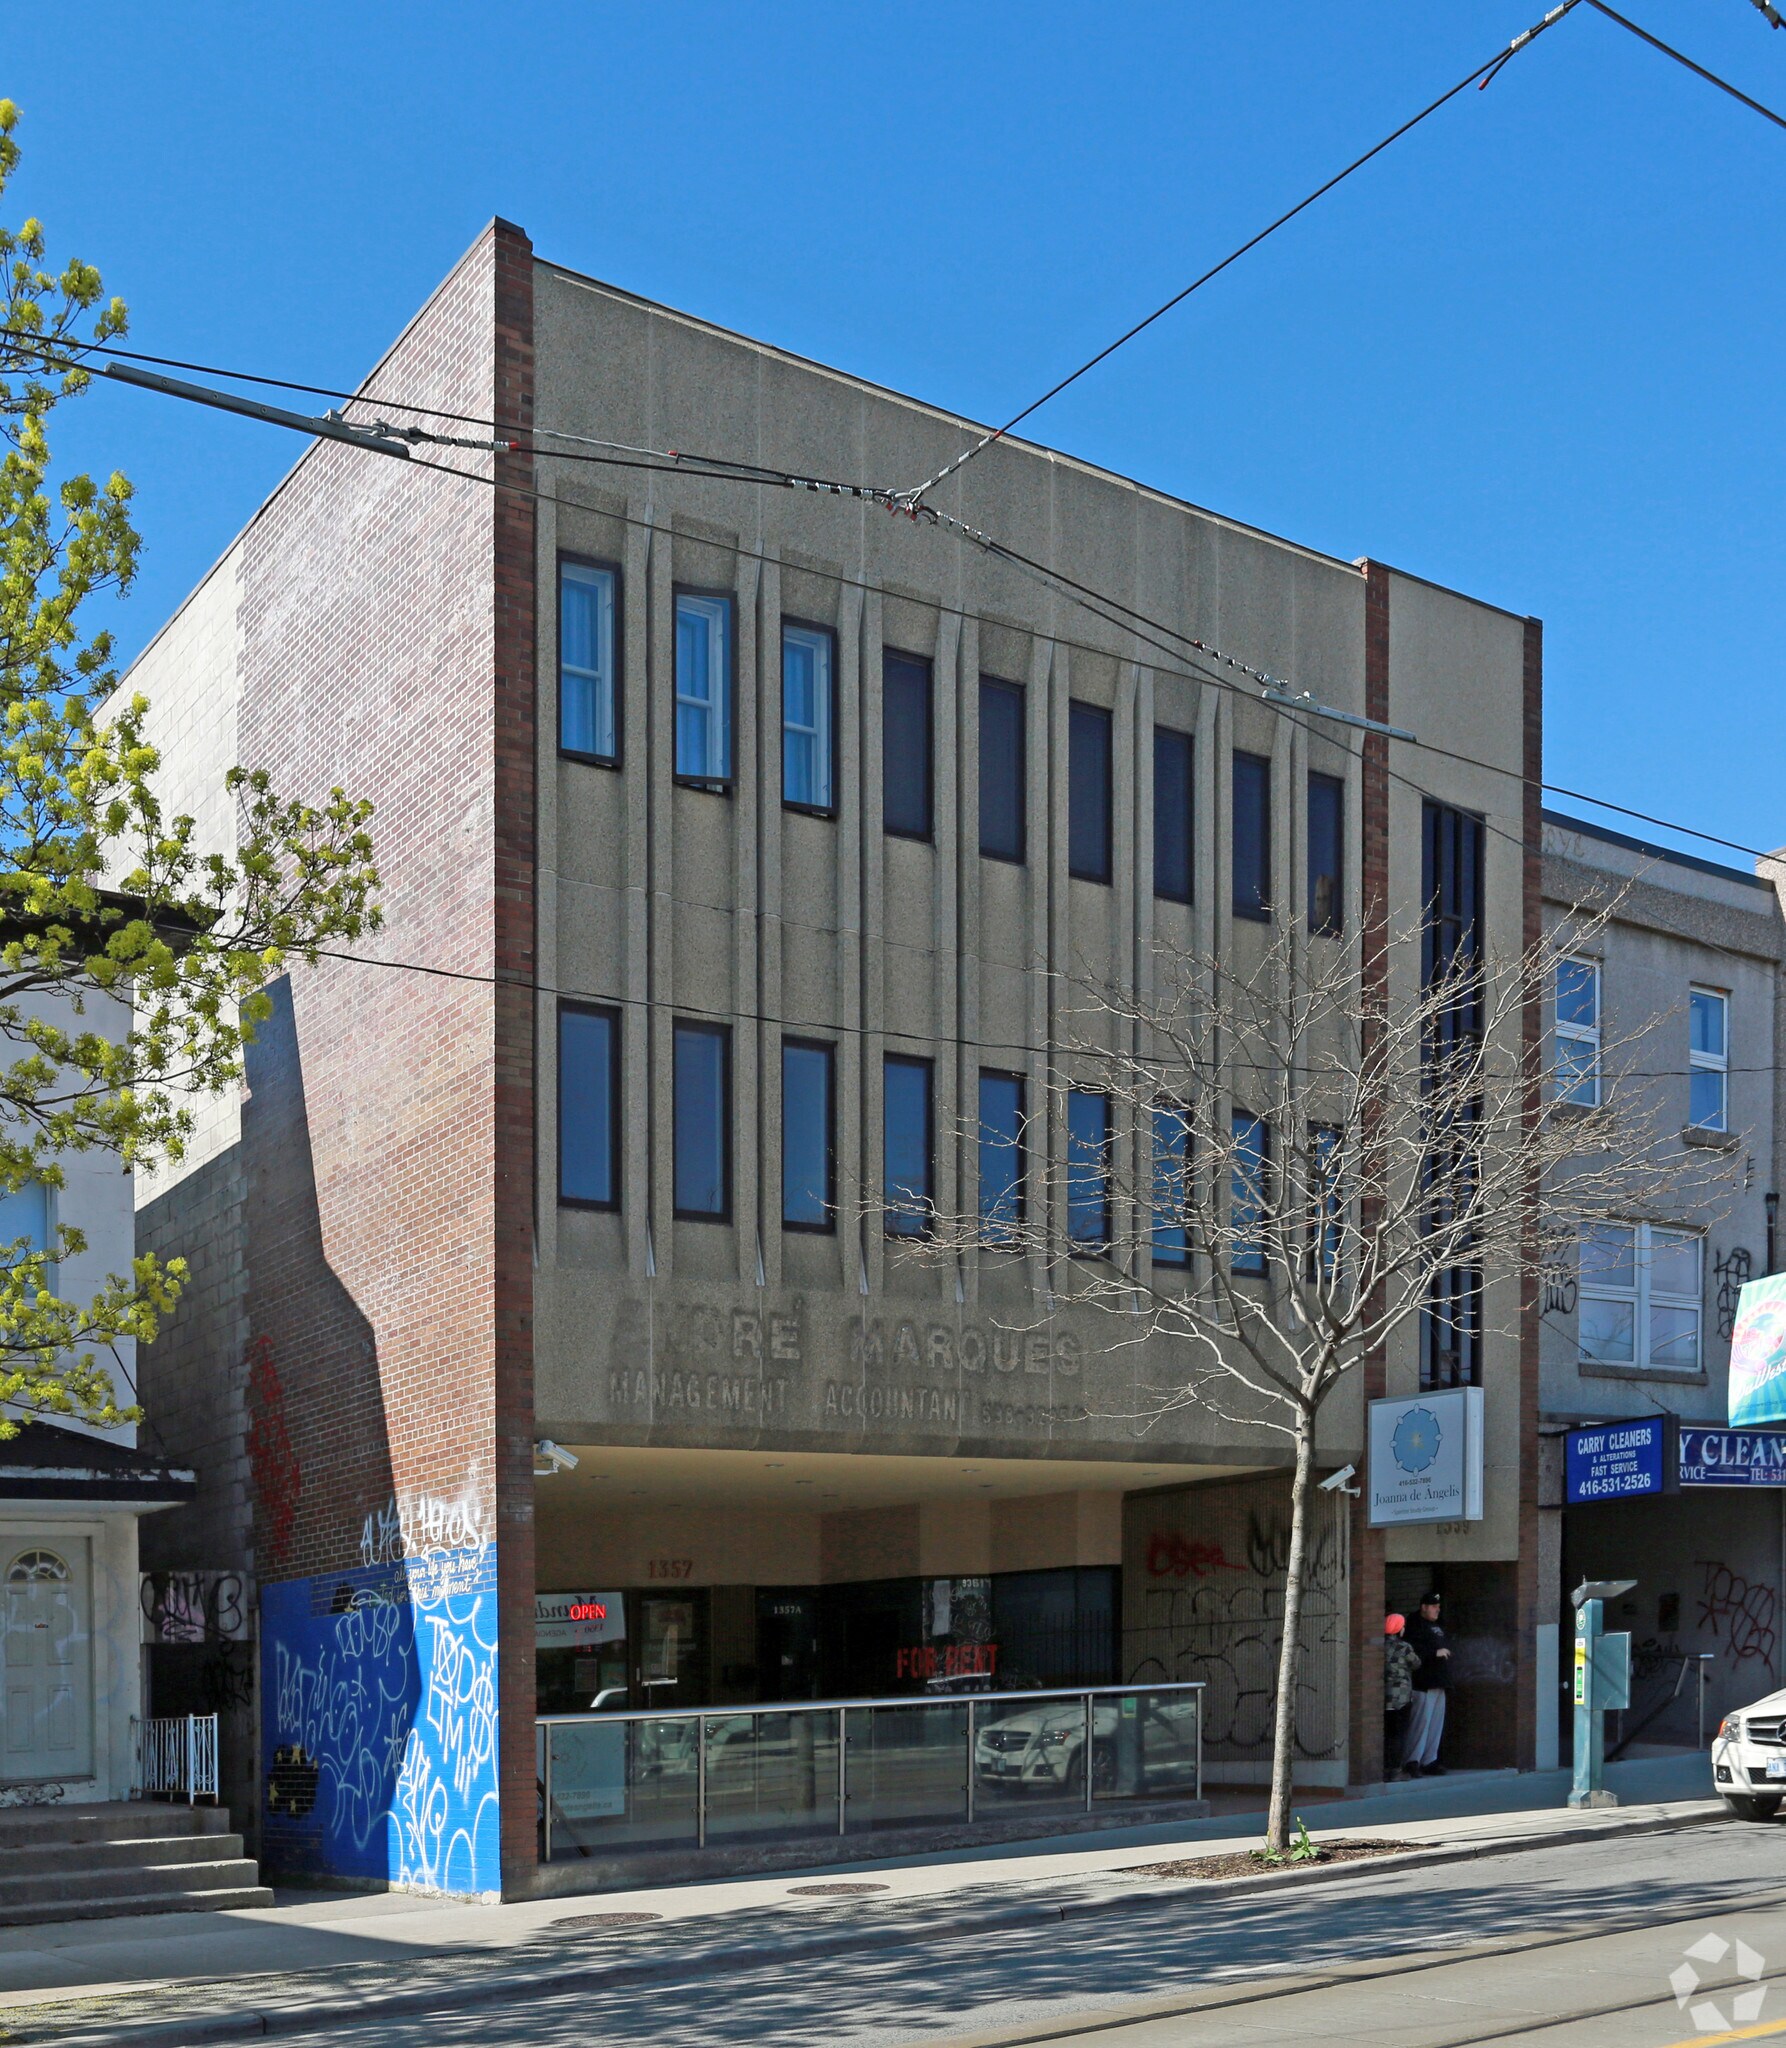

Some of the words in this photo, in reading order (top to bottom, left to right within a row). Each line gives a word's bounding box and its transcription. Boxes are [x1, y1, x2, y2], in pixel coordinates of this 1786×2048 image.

[609, 1369, 787, 1412] MANAGEMENT
[1578, 1435, 1605, 1455] CARRY
[1609, 1428, 1652, 1450] CLEANERS
[1600, 1450, 1636, 1462] ALTERATIONS
[1591, 1466, 1607, 1477] FAST
[1610, 1461, 1638, 1475] SERVICE
[1579, 1473, 1651, 1496] 416-531-2526
[1374, 1492, 1408, 1507] Joanna
[1410, 1488, 1422, 1500] de
[648, 1558, 693, 1579] 1357
[569, 1603, 607, 1621] OPEN
[773, 1605, 802, 1615] 1357A
[896, 1646, 938, 1679] FOR
[944, 1644, 998, 1677] RENT
